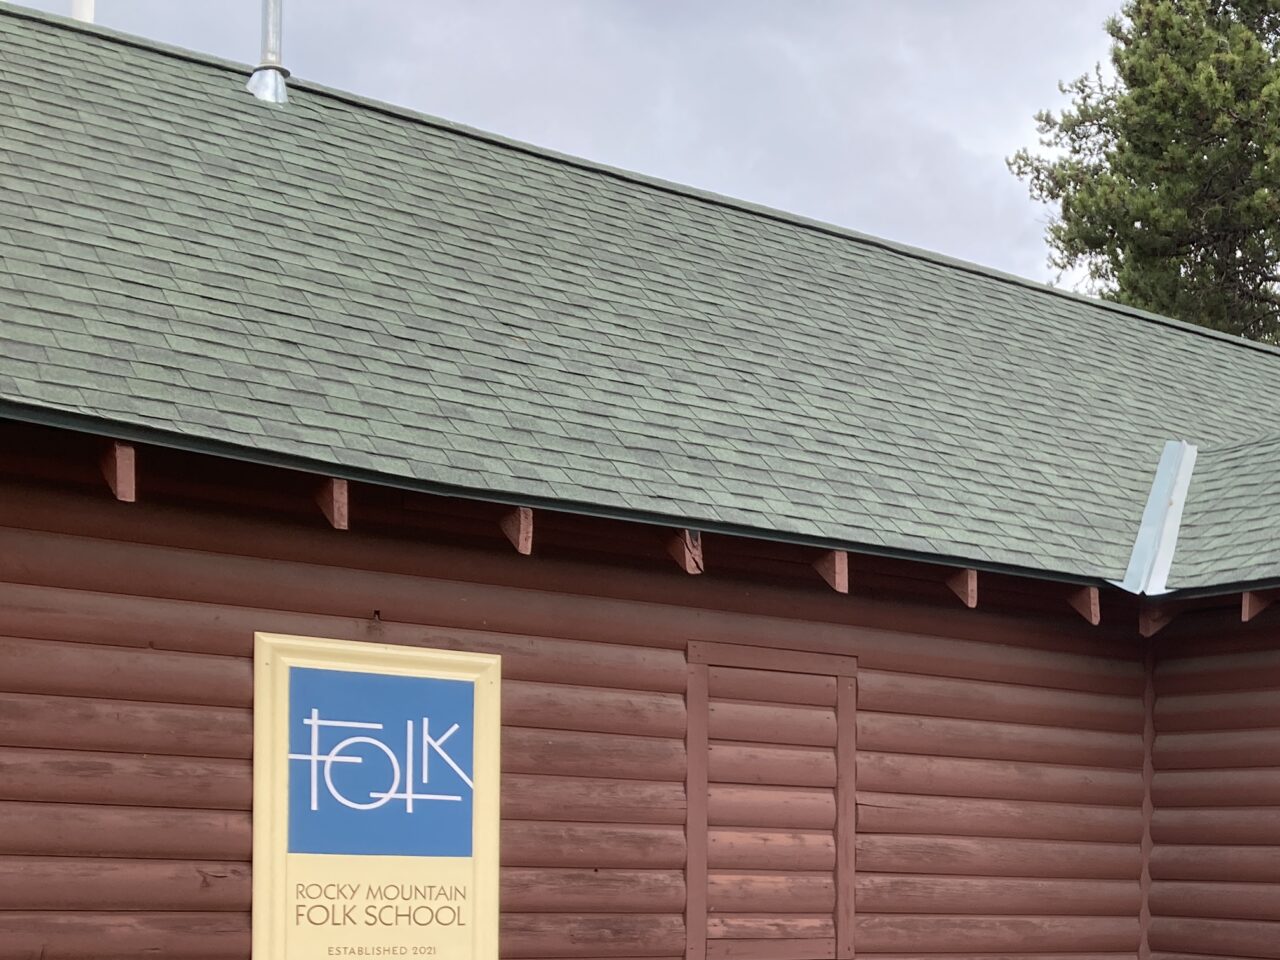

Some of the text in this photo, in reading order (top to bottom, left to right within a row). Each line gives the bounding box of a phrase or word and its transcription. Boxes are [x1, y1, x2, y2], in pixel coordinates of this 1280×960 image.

[288, 708, 474, 813] FOLK
[296, 883, 466, 901] ROCKY MOUNTAIN
[296, 904, 466, 926] FOLK SCHOOL
[328, 946, 436, 956] ESTABLISHED 2021
